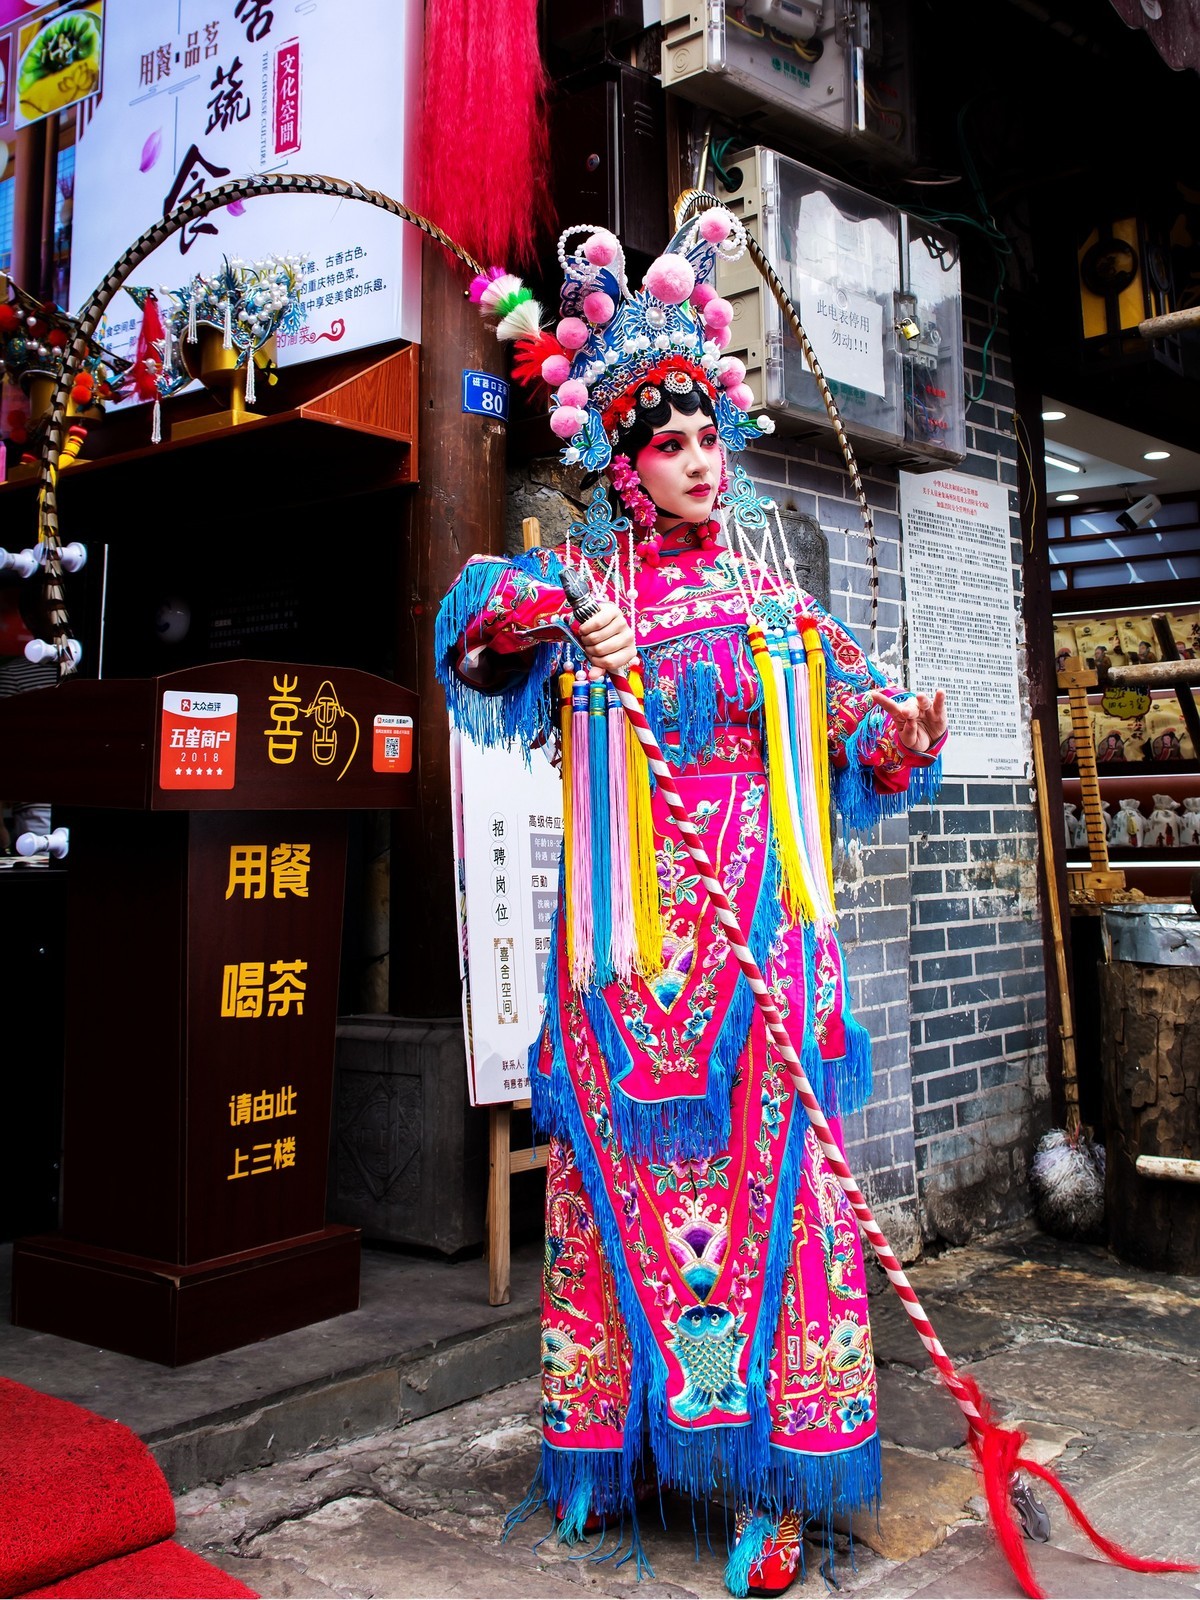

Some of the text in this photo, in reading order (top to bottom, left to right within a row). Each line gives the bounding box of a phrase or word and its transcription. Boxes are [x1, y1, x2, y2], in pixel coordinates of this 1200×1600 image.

[279, 54, 297, 145] 文化空間
[260, 118, 268, 166] CULTURE
[817, 299, 870, 333] 此电表停用
[482, 391, 503, 414] 80
[192, 701, 222, 711] 大众点评
[169, 726, 231, 748] 五星商户
[181, 752, 219, 762] 2018
[225, 842, 311, 900] 用餐
[492, 819, 509, 921] 招聘岗位
[531, 874, 548, 888] 后勤
[221, 959, 308, 1019] 喝茶
[500, 947, 513, 1015] 喜舍空间
[229, 1084, 298, 1127] 请由此
[227, 1136, 296, 1181] 上三楼
